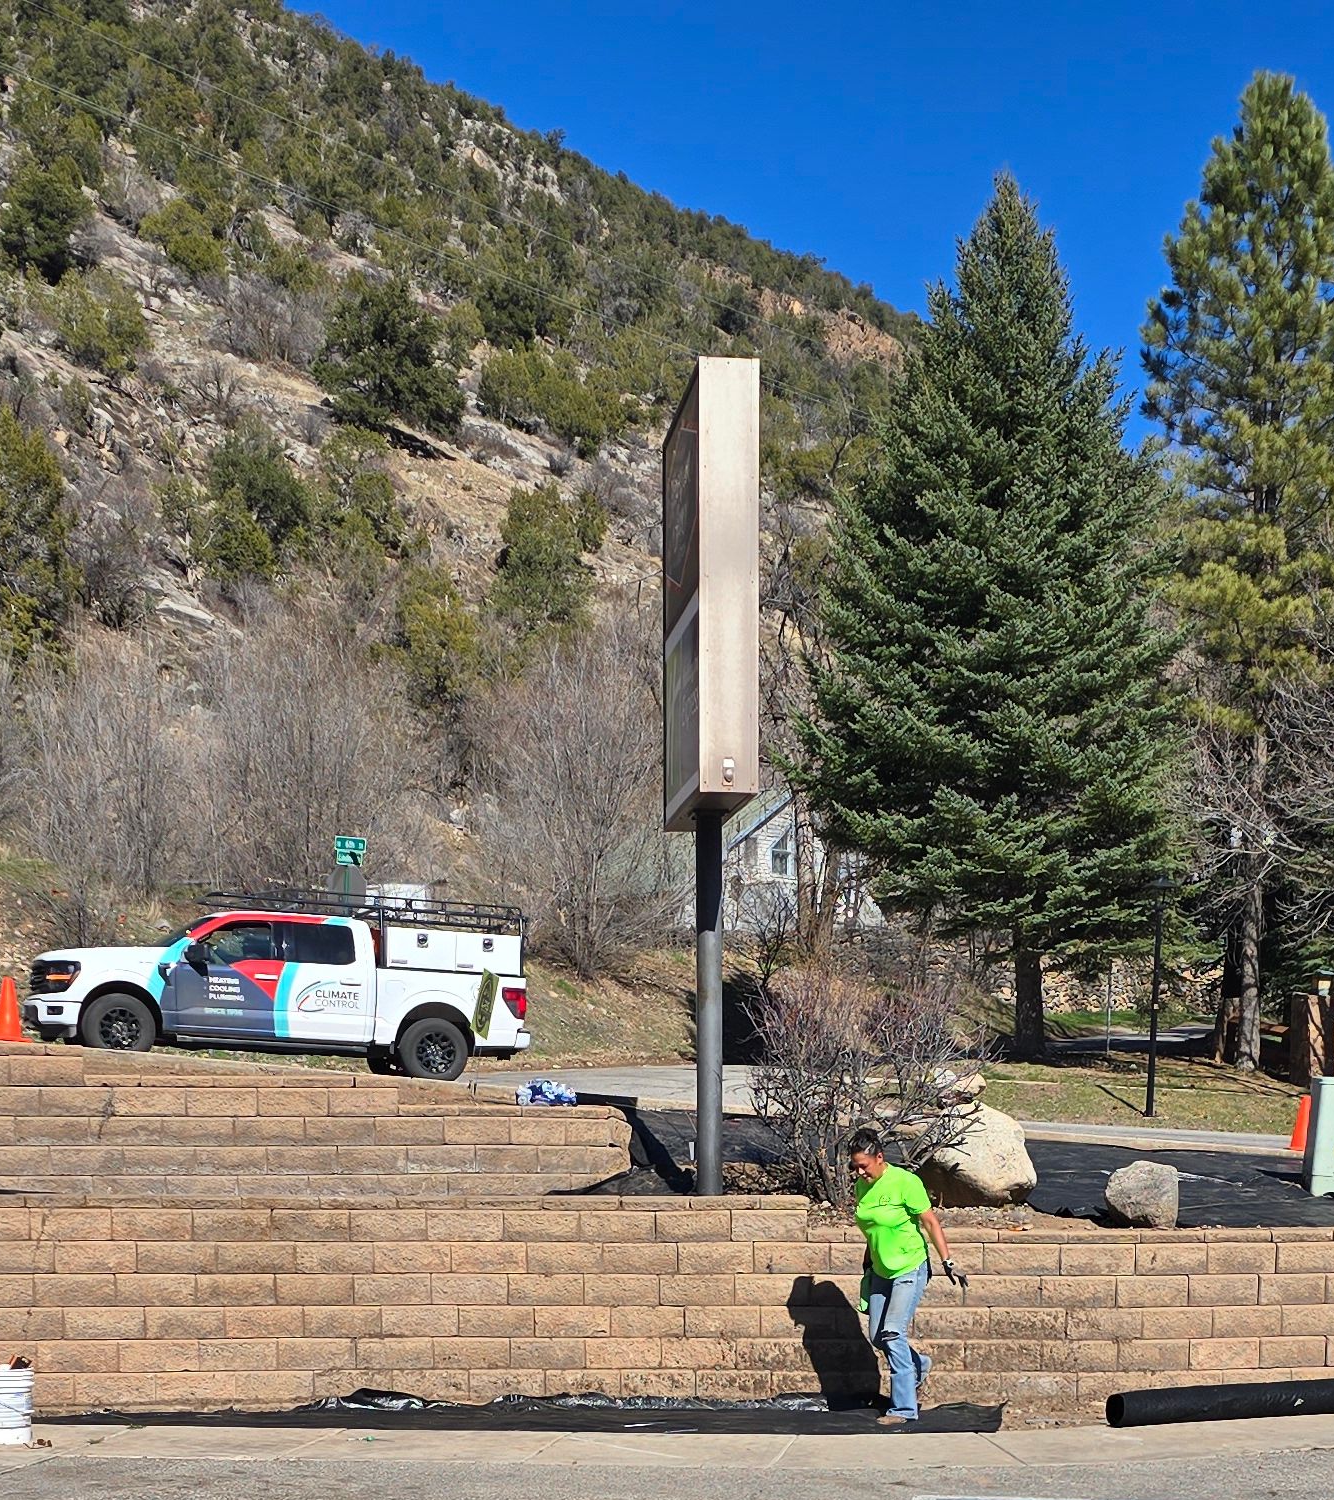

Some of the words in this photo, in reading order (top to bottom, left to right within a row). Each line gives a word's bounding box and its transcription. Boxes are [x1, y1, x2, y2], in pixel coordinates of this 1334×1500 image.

[209, 985, 240, 993] COOLING
[315, 989, 360, 1000] CLIMATE
[315, 999, 360, 1009] CONTROL
